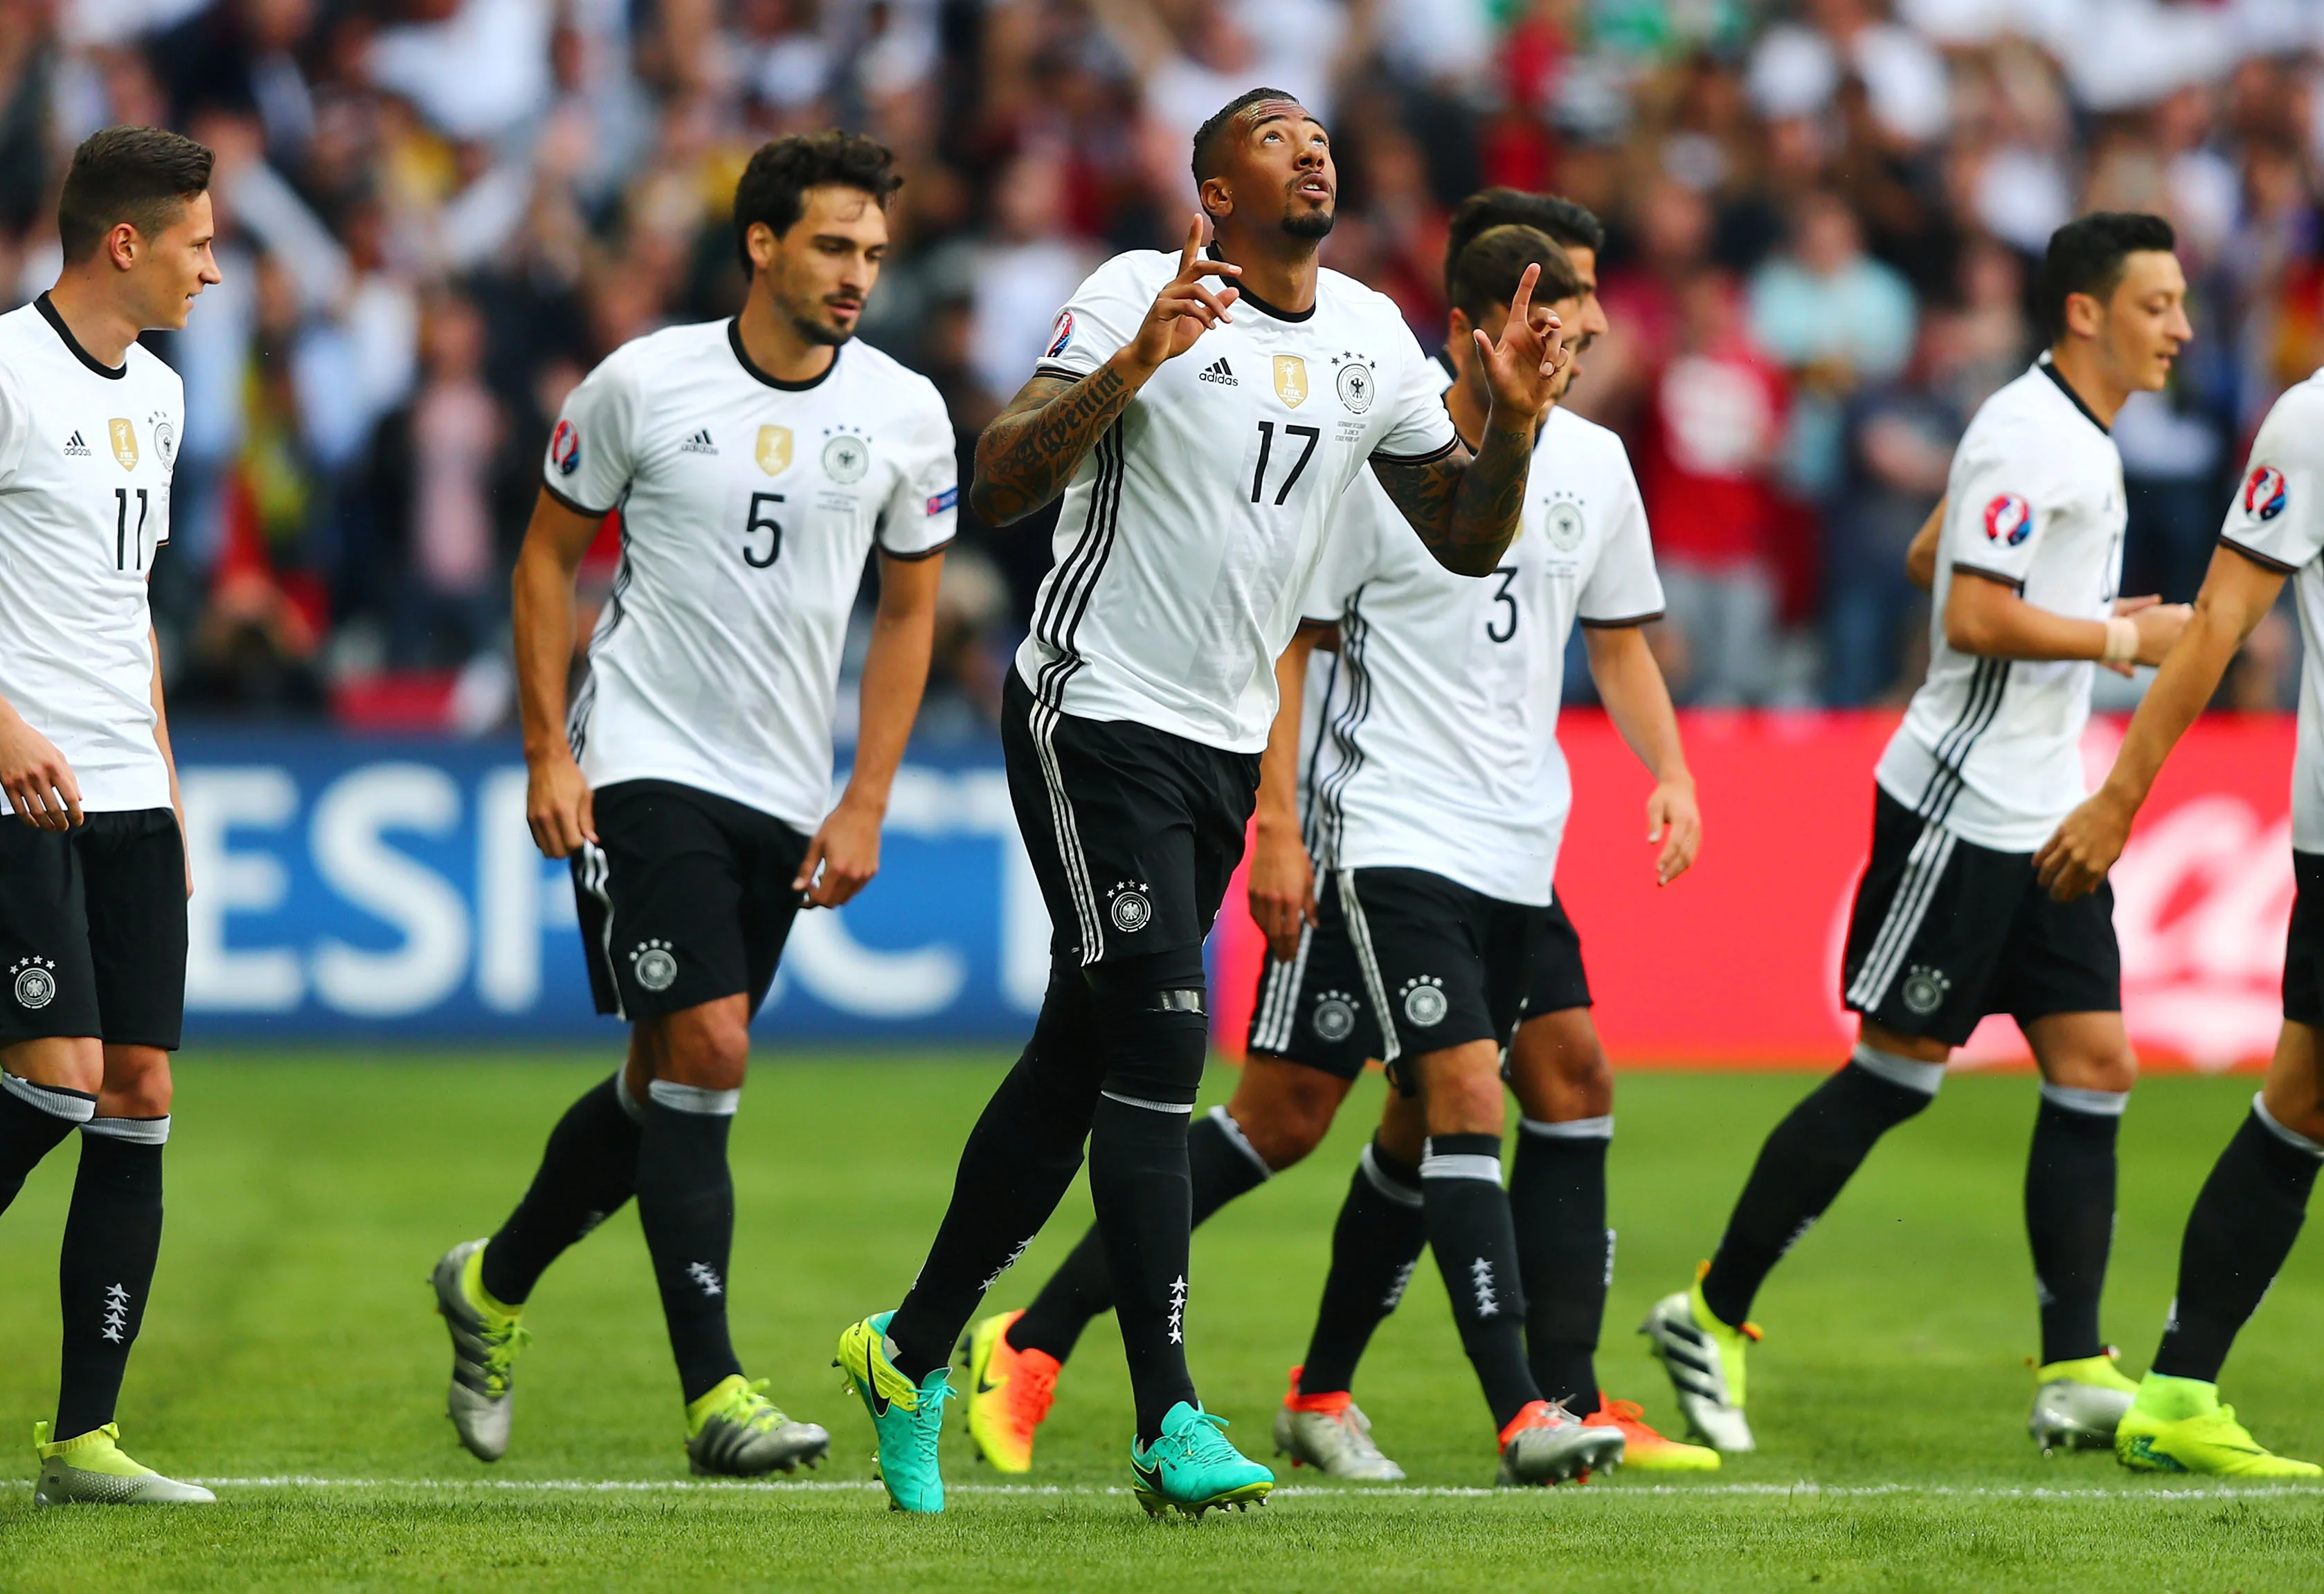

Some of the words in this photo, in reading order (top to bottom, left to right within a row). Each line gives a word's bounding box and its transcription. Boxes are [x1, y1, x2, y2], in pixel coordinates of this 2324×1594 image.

[1198, 372, 1238, 387] adidas
[64, 445, 91, 456] adidas
[681, 442, 720, 456] adidas
[1251, 421, 1320, 506] 17
[115, 488, 148, 570] 11
[743, 492, 787, 568] 5
[1487, 566, 1518, 643] 3
